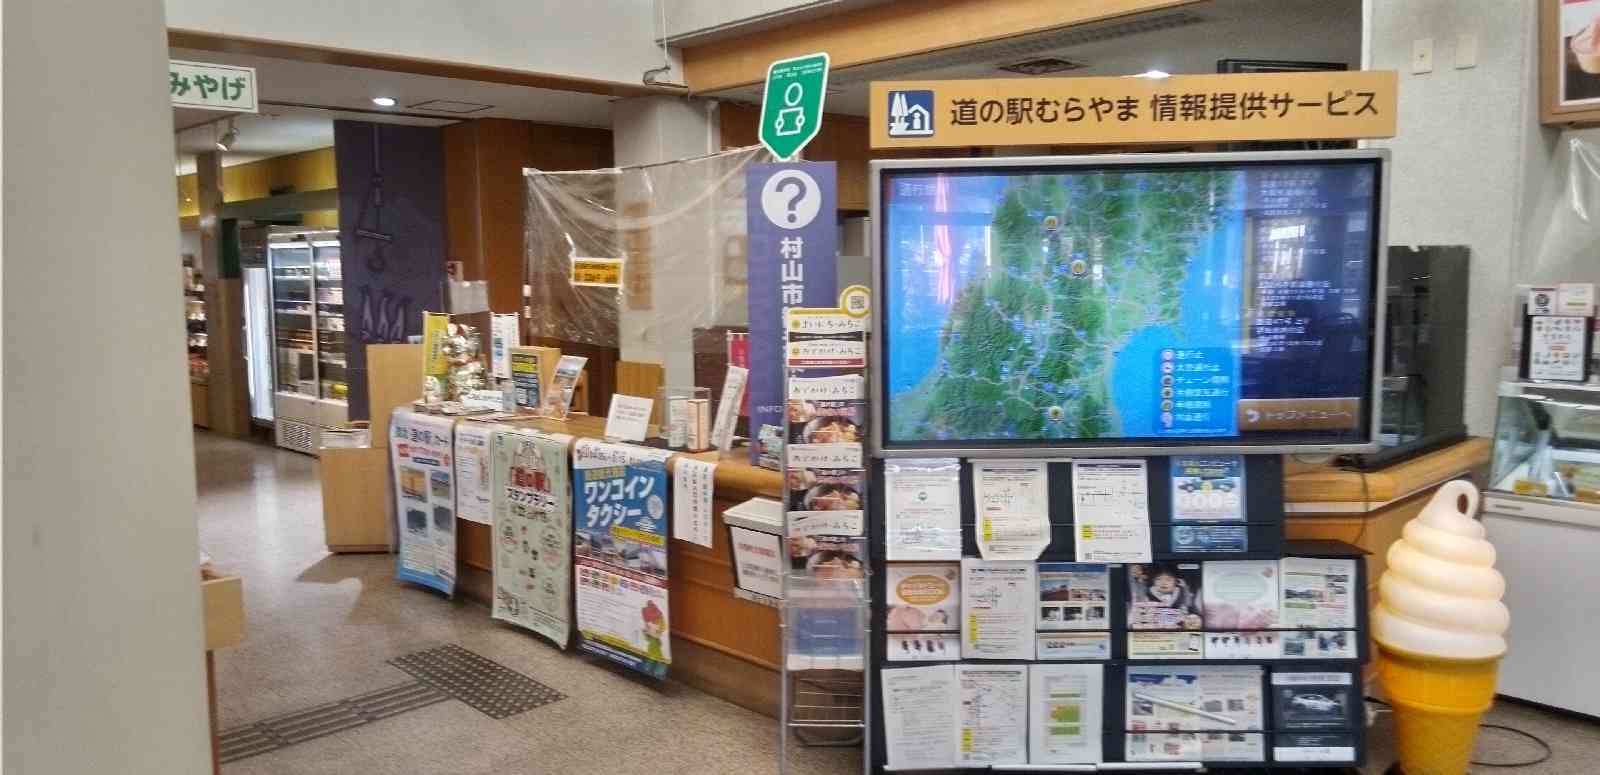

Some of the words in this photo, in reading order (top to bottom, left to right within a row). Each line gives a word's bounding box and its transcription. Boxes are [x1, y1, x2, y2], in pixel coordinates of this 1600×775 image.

[170, 71, 246, 100] みやげ
[951, 97, 1139, 127] 道の駅むらやま
[1151, 90, 1379, 122] 情報提供サービス
[780, 236, 804, 318] 村山市
[584, 475, 656, 504] ワンコイン
[587, 502, 642, 527] タクシー
